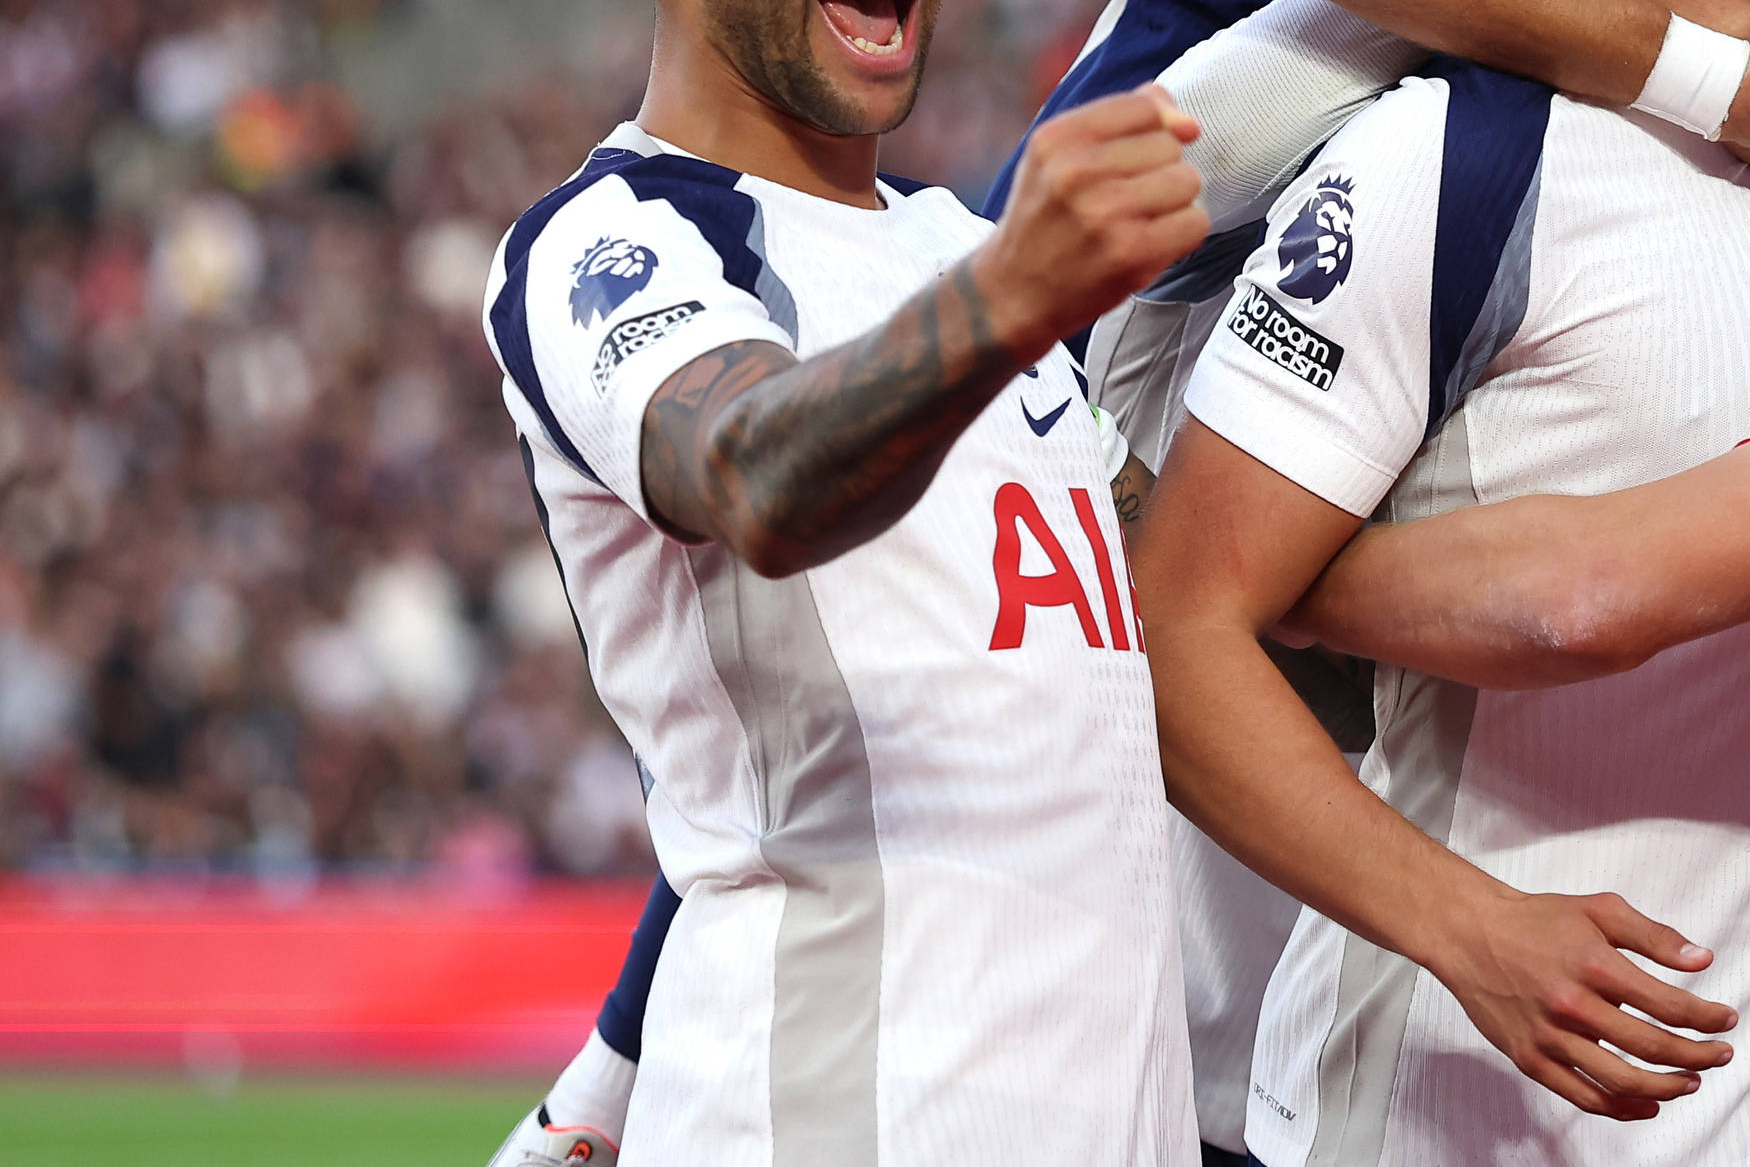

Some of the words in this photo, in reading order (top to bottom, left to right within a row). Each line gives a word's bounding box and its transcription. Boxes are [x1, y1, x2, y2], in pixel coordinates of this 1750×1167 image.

[611, 306, 693, 346] room
[1228, 305, 1258, 338] for
[1251, 329, 1333, 390] racism
[1239, 285, 1270, 320] No
[1264, 310, 1329, 364] room
[989, 482, 1146, 655] AI
